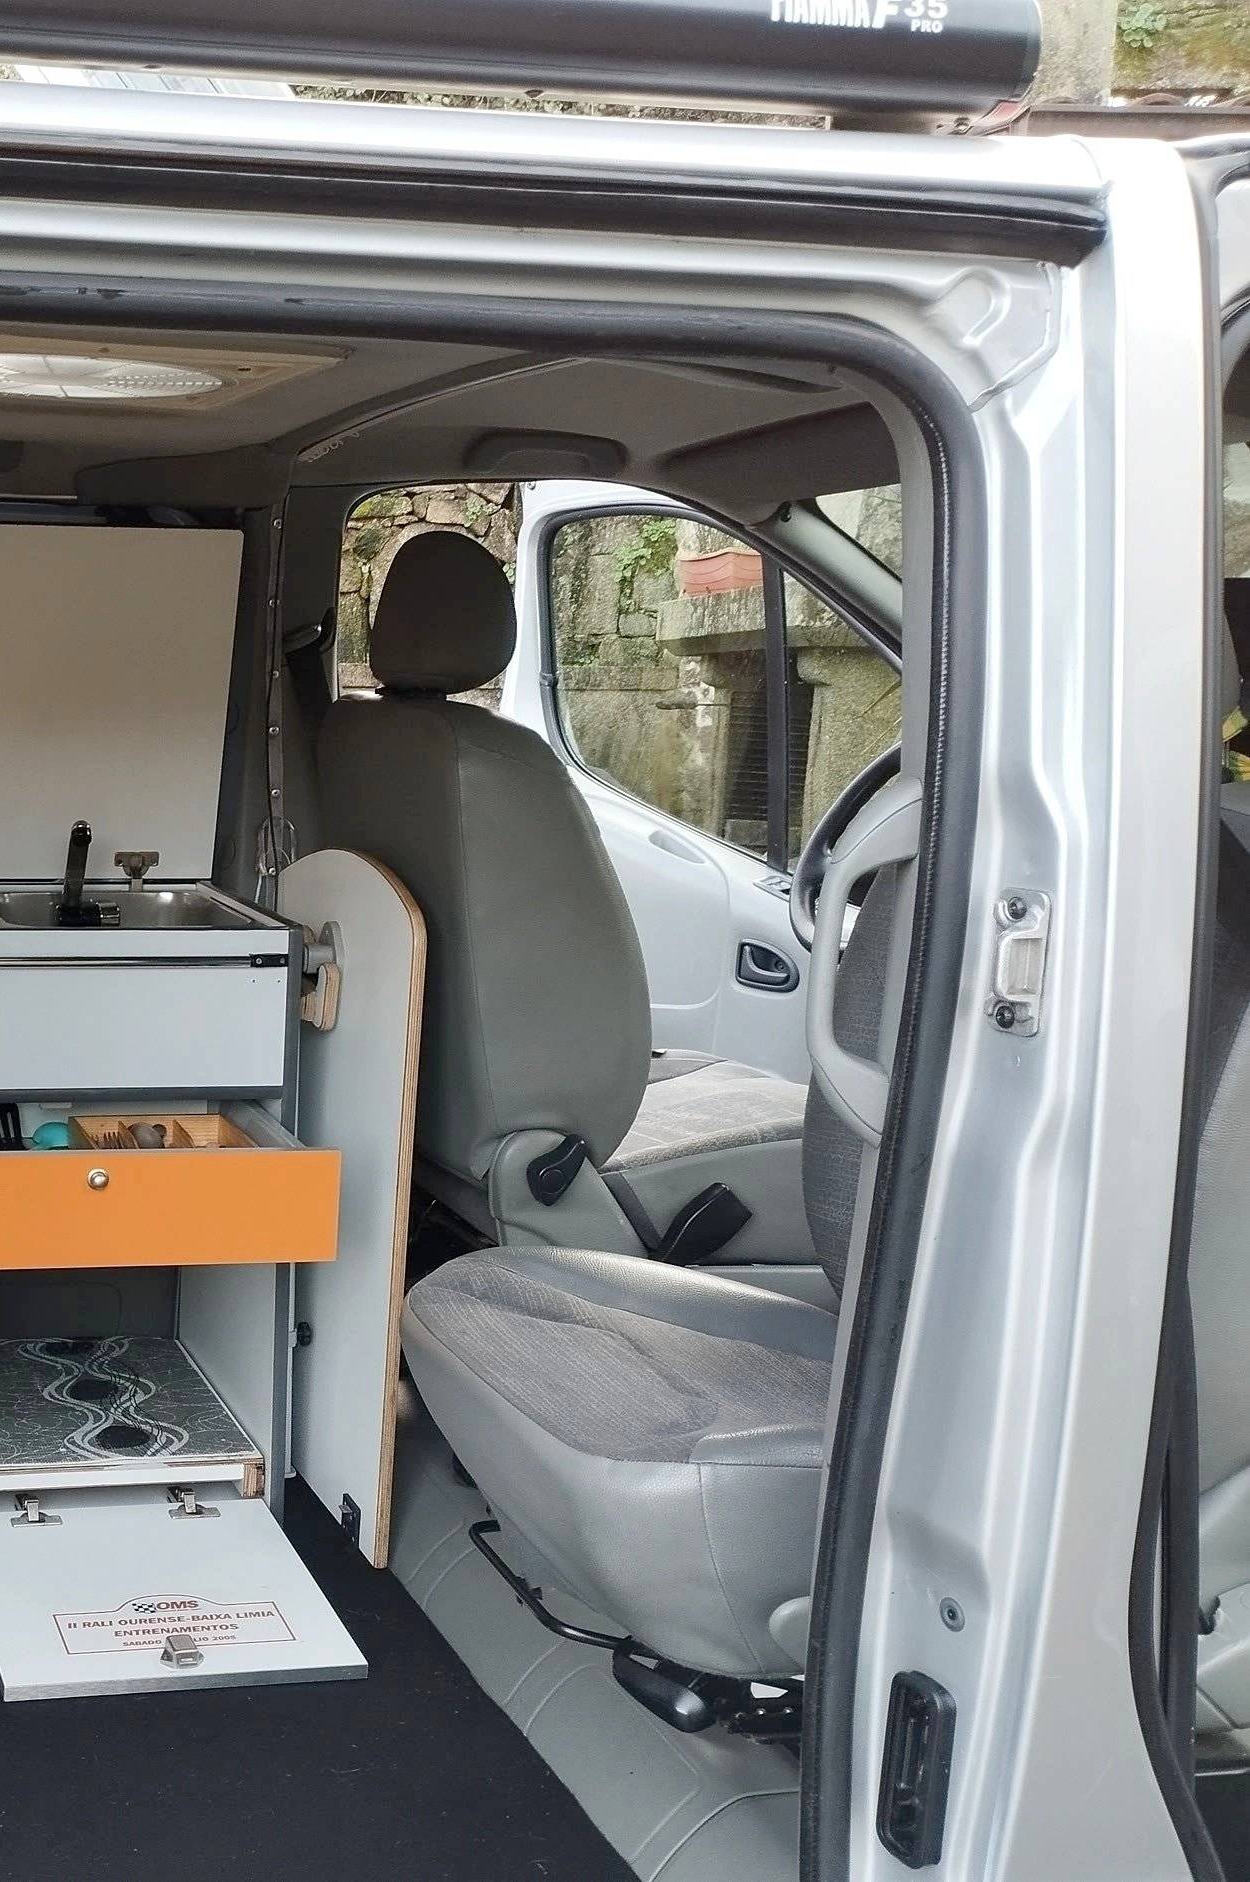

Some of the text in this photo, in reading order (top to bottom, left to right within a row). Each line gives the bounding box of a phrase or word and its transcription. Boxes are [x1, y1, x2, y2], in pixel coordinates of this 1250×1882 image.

[910, 19, 944, 33] PRO
[156, 1600, 199, 1611] OMS
[67, 1610, 275, 1630] II RALI OURENSE-BAIXA LIMIA
[114, 1623, 239, 1637] ENTRENAMENTOS
